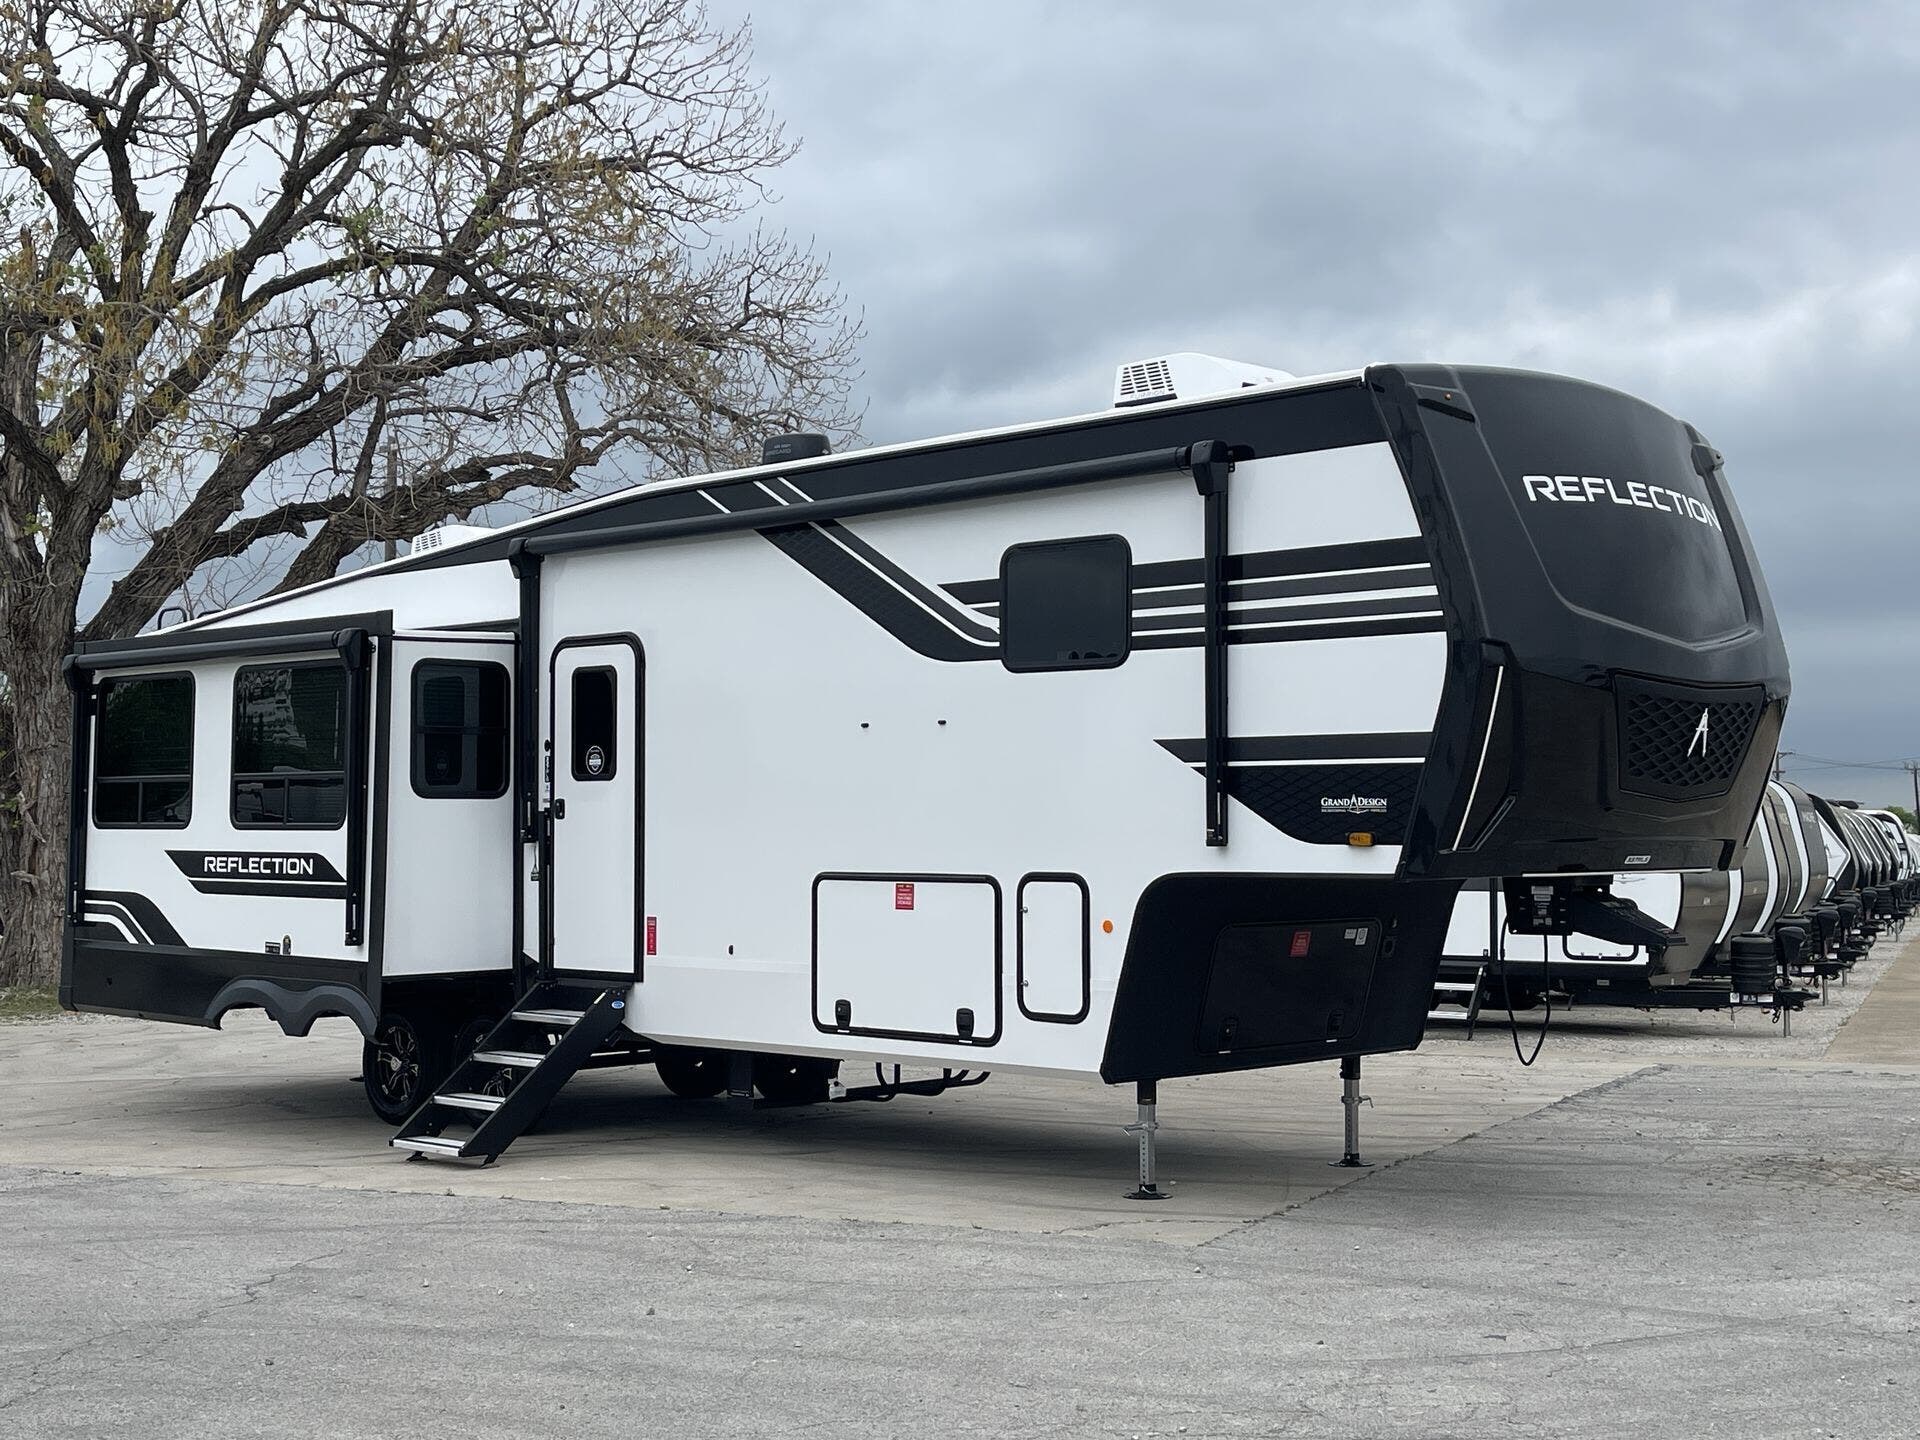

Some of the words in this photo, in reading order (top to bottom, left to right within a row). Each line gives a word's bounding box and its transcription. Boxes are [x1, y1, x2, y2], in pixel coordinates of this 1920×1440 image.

[1522, 475, 1722, 532] REFLECTION
[1320, 797, 1350, 807] GRAND
[1358, 797, 1387, 807] DESIGN
[204, 856, 314, 875] REFLECTION
